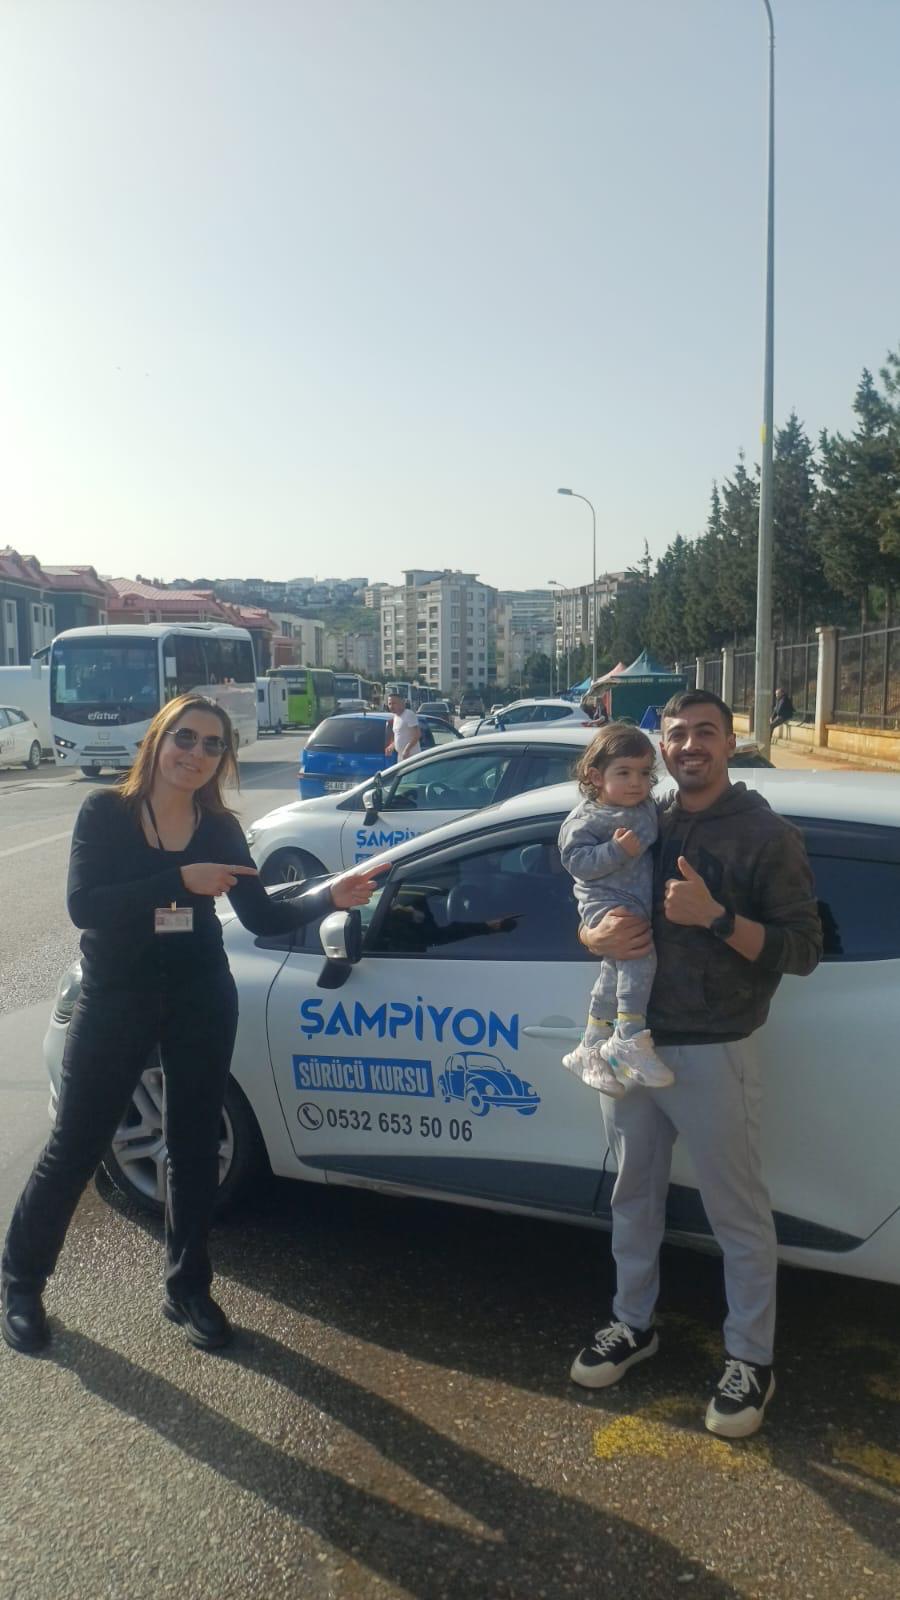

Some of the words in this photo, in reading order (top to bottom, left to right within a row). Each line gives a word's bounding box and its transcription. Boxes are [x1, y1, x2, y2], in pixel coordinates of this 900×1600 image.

[300, 995, 519, 1050] ŞAMPİYON
[299, 1058, 366, 1090] SÜRÜCÜ
[370, 1063, 428, 1094] KURSU
[326, 1108, 372, 1131] 0532
[378, 1113, 413, 1135] 653
[419, 1116, 442, 1138] 50
[449, 1119, 473, 1142] 06
